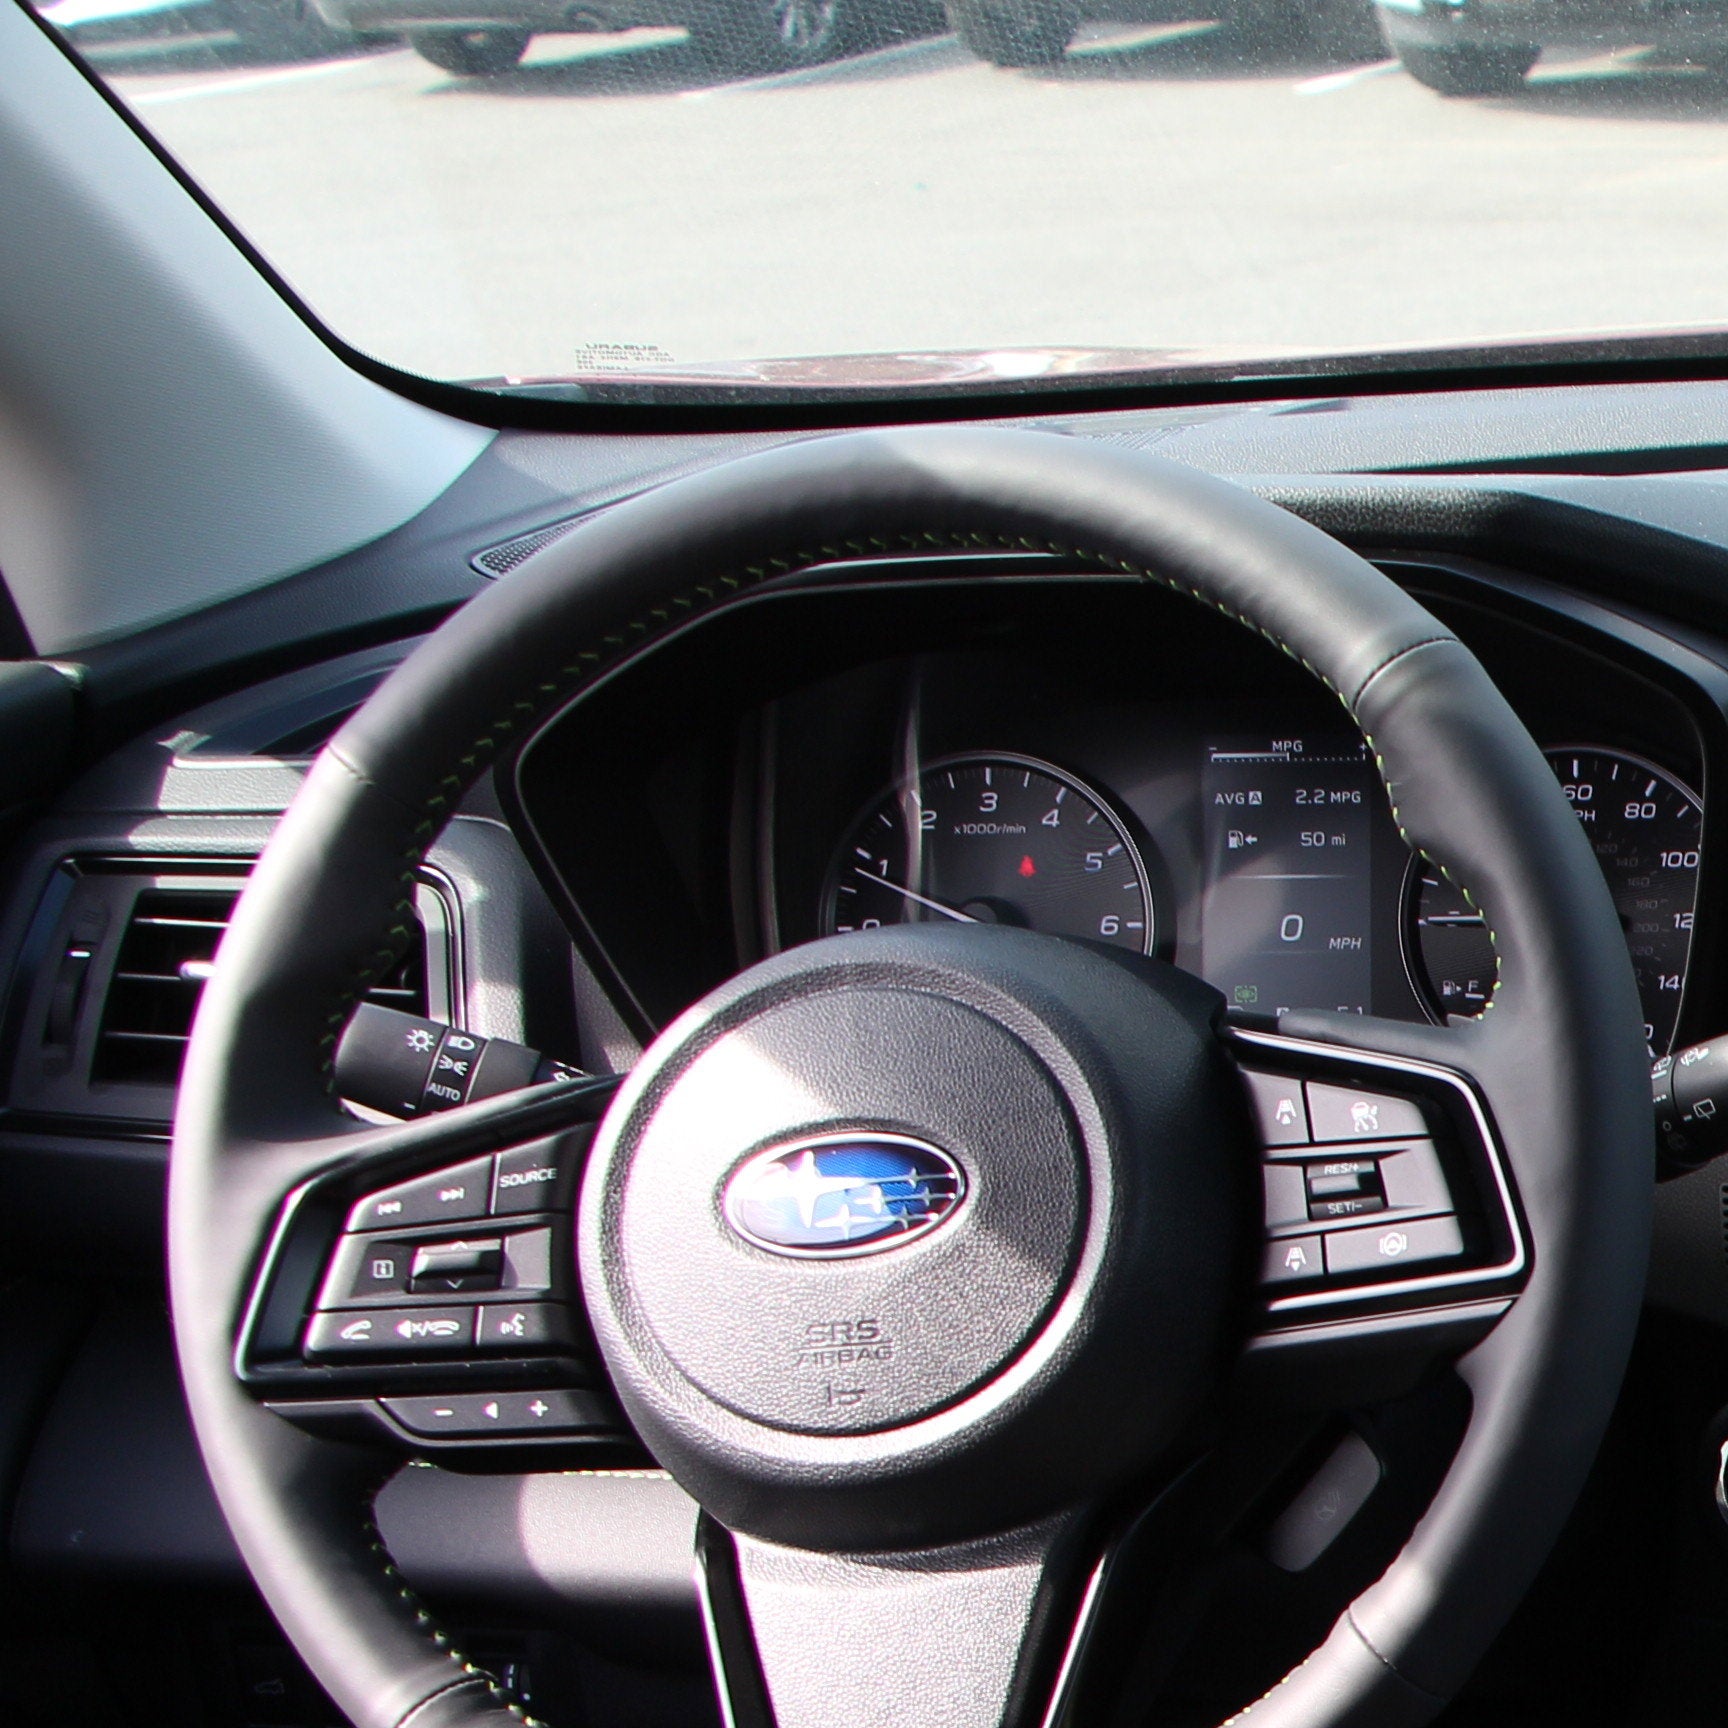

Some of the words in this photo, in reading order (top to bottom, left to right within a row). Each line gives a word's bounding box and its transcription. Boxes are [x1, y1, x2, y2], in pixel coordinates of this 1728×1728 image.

[1272, 740, 1303, 752] MPG
[1214, 792, 1245, 805] AVG
[1295, 789, 1325, 804] 2.2
[1330, 792, 1361, 804] MPG
[1562, 784, 1592, 801] 60
[978, 792, 999, 813] 3
[1624, 802, 1656, 820] 80
[920, 810, 938, 830] 2
[1041, 809, 1060, 828] 4
[1300, 832, 1326, 847] 50
[1331, 833, 1346, 846] mi
[878, 860, 889, 877] 1
[1084, 852, 1103, 872] 5
[1660, 851, 1699, 868] 100
[1099, 915, 1120, 936] 6
[1280, 914, 1304, 942] 0
[1329, 937, 1362, 950] MPH
[1468, 981, 1480, 992] F
[428, 1081, 461, 1102] AUTO
[499, 1167, 558, 1188] SOURCE
[805, 1320, 880, 1343] SRS
